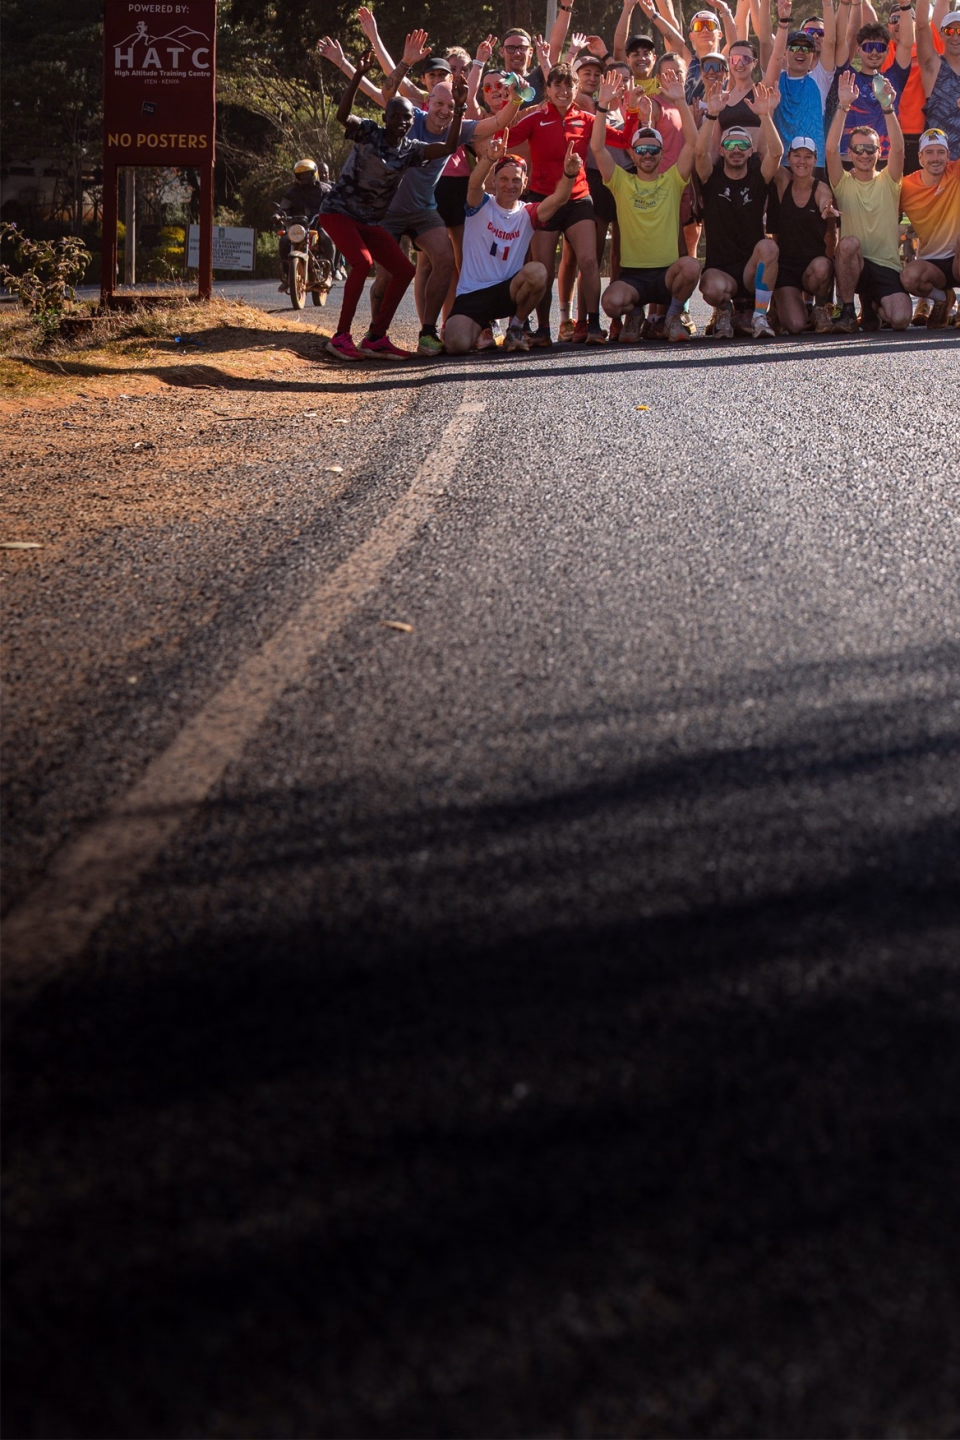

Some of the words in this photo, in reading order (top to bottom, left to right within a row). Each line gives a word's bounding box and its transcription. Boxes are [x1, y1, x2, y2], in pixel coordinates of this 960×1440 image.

[128, 3, 173, 13] POWERED
[175, 5, 190, 14] BY:
[114, 47, 210, 69] HATC
[114, 69, 130, 77] High
[159, 70, 187, 78] Training
[108, 133, 132, 147] NO
[136, 133, 207, 149] POSTERS
